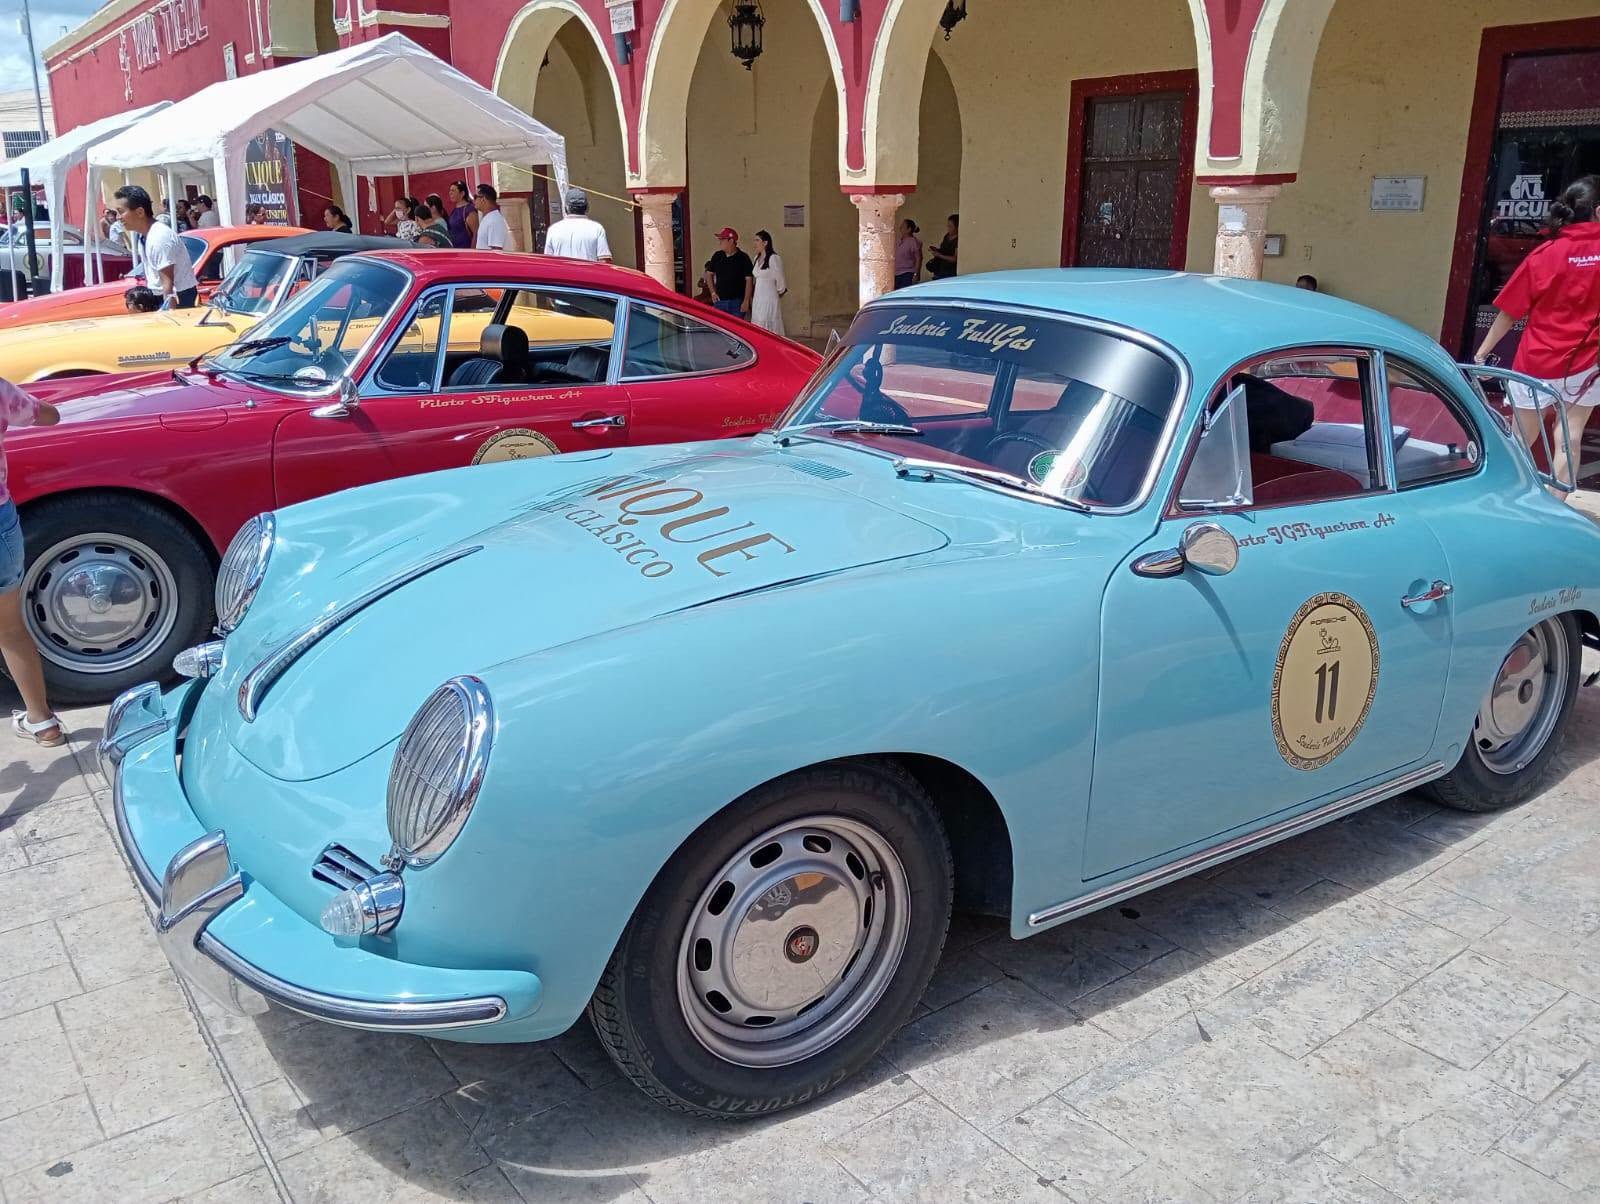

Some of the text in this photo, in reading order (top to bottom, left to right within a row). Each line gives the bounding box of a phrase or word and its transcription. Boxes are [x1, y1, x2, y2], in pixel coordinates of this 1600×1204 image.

[160, 0, 209, 55] TICUL
[1497, 201, 1551, 217] TICUL
[418, 399, 468, 409] Piloto
[565, 509, 673, 577] CLASICO
[1315, 660, 1340, 724] 11
